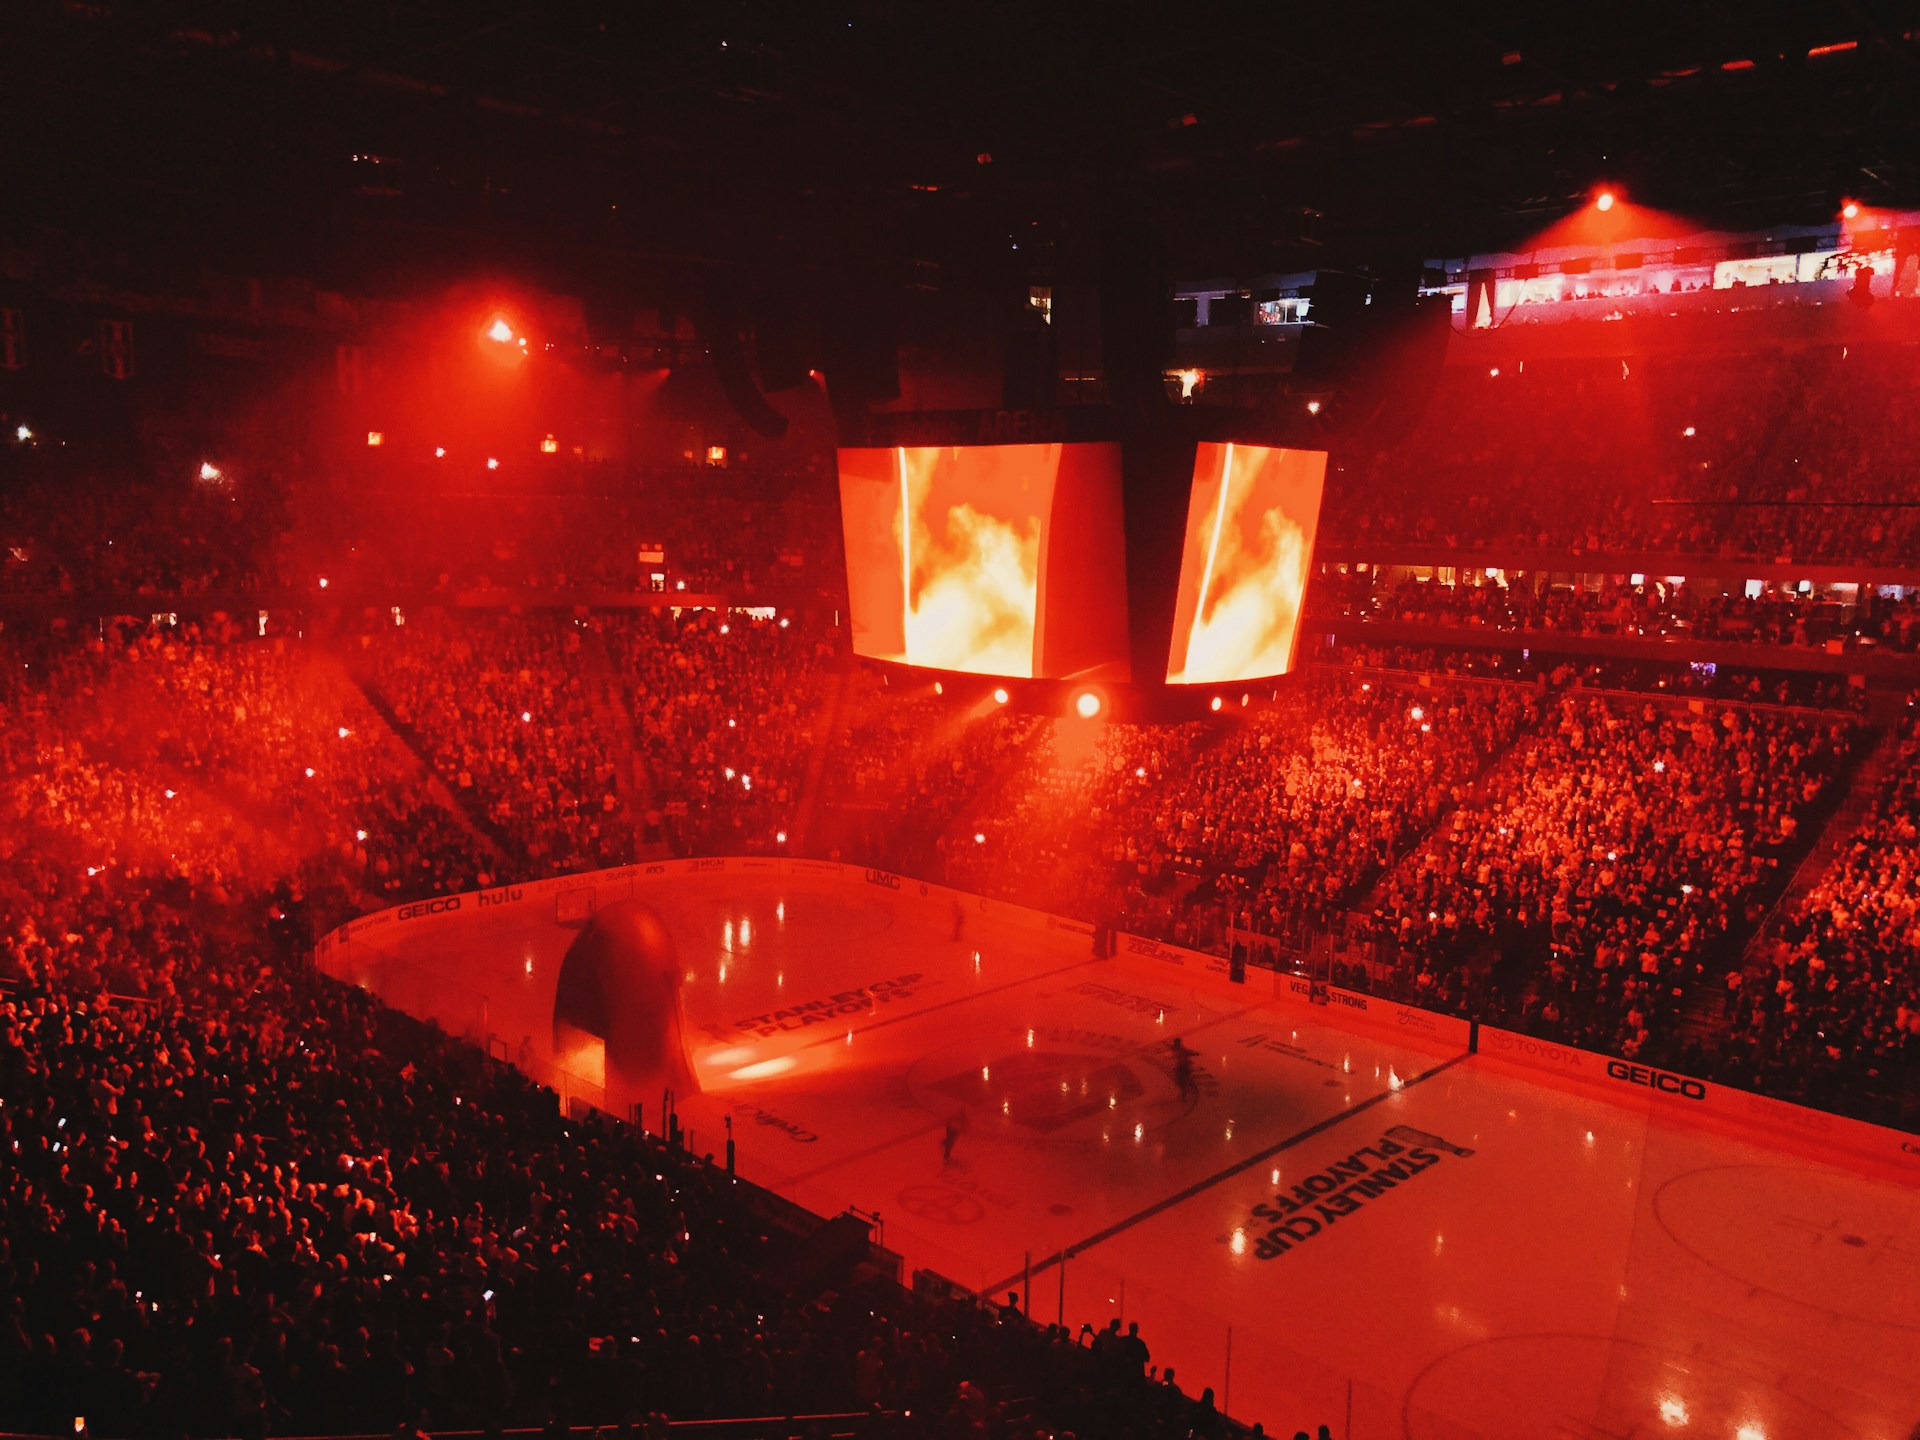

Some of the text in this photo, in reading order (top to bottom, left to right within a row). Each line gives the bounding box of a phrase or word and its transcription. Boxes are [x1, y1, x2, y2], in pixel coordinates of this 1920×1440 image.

[976, 409, 1069, 443] ARENA
[478, 886, 523, 907] hulu
[865, 870, 900, 891] UMC
[397, 896, 461, 920] GEICO
[733, 972, 924, 1029] STANLEY CUP
[1290, 980, 1367, 1011] VEGAS STRONG
[1516, 1038, 1581, 1067] TOYOTA
[1606, 1060, 1706, 1100] GEICO
[1251, 1137, 1407, 1225] PLAYOFFS
[1252, 1147, 1441, 1263] STANLEY CUP
